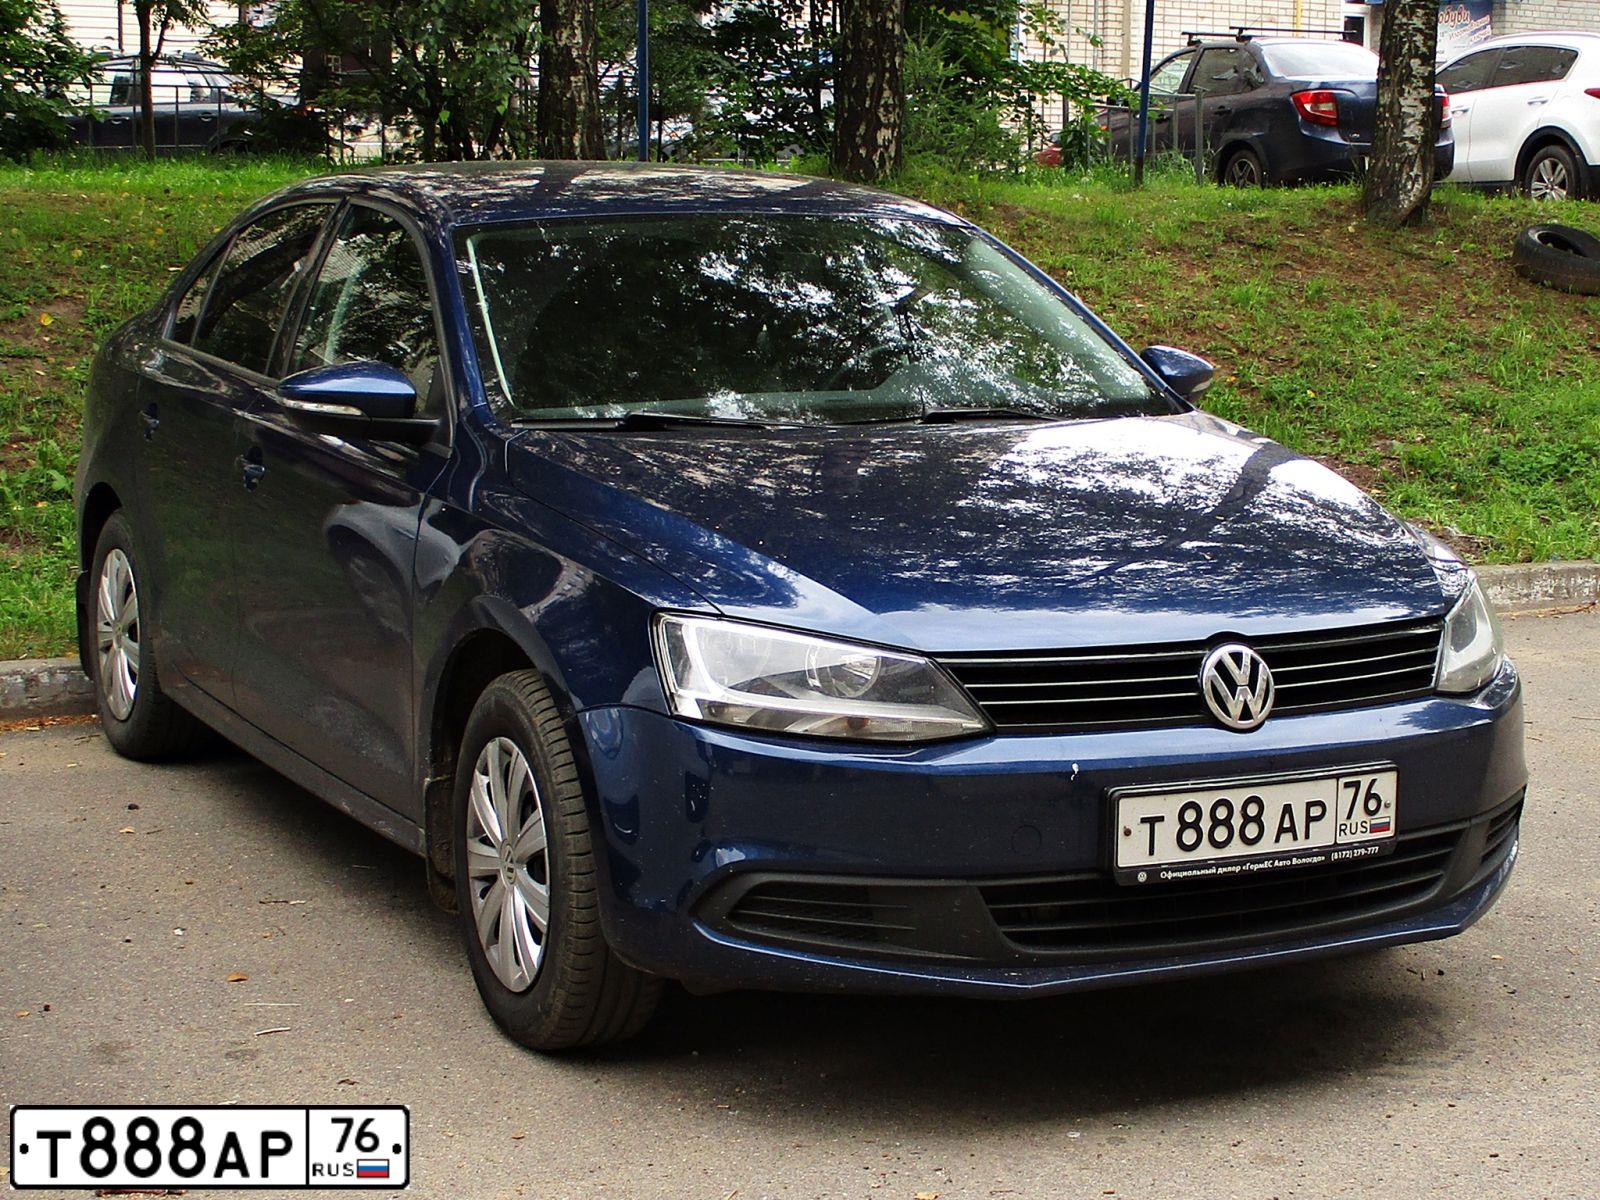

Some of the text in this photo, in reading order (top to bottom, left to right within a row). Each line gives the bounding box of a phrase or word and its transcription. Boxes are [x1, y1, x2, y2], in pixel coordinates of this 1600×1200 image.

[1140, 778, 1383, 856] Т888АР 76
[1338, 821, 1368, 836] RUS
[1331, 846, 1380, 861] (8172) 279-777
[1160, 866, 1216, 879] Официальный
[1217, 864, 1241, 875] дилер
[1274, 859, 1291, 867] Авто
